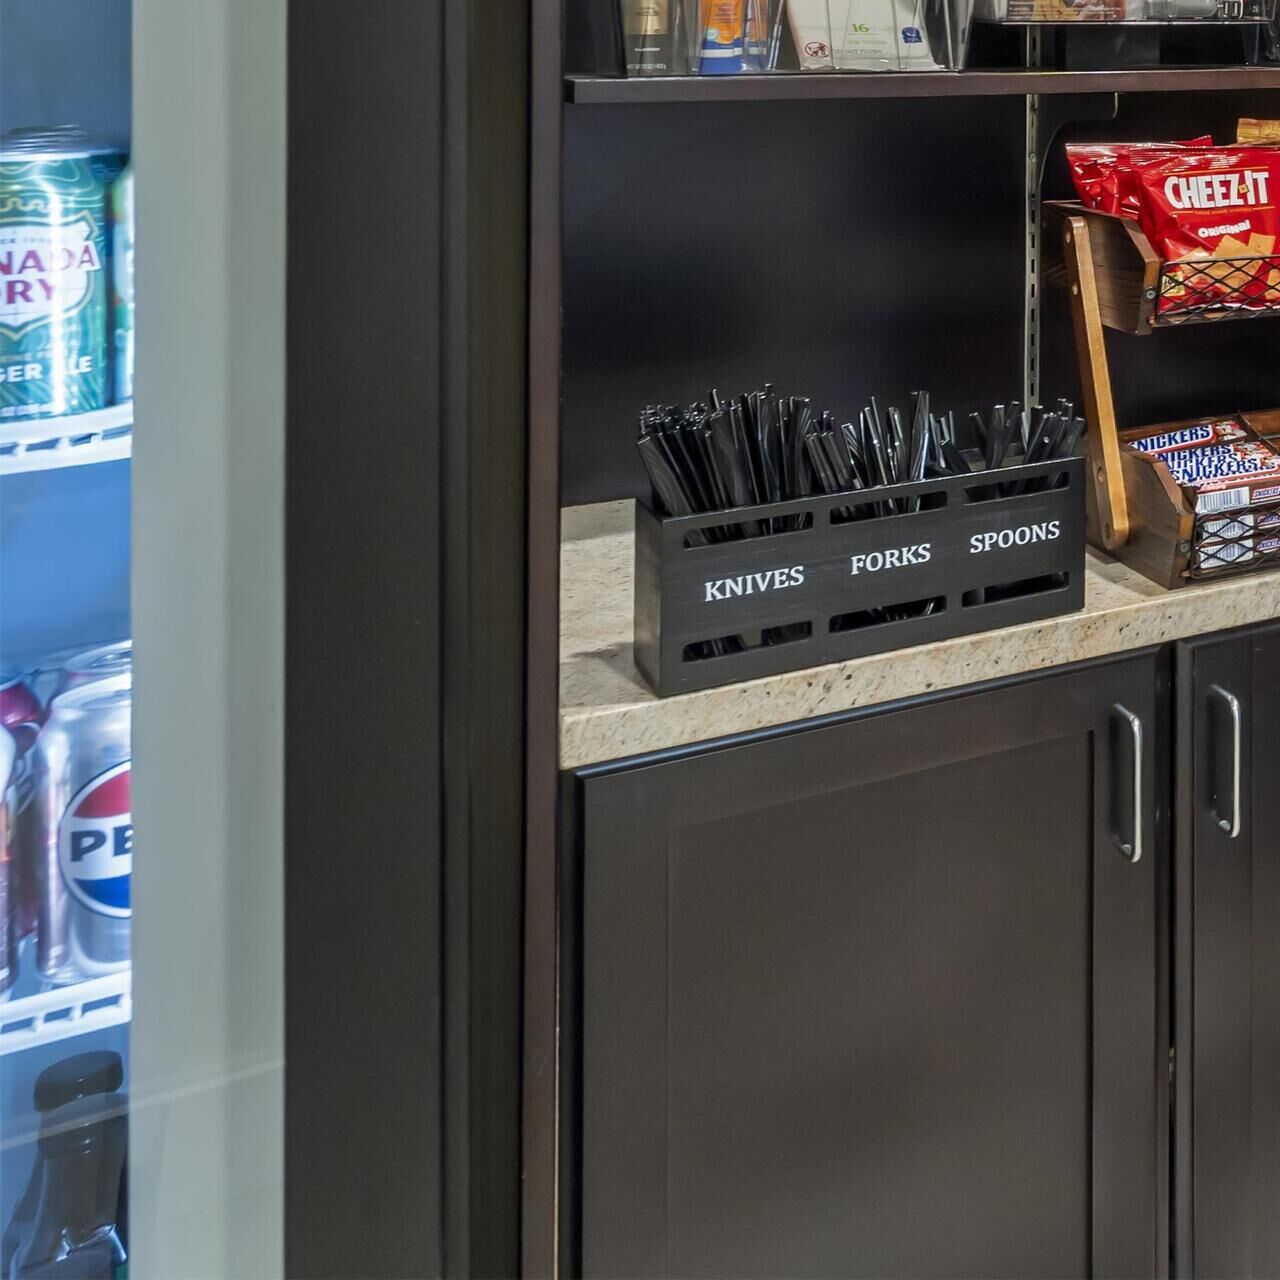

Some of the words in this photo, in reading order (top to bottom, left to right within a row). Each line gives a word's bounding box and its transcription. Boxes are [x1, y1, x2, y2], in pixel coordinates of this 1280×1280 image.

[852, 23, 869, 33] 16
[1164, 170, 1269, 208] CHEEZ-IT
[1129, 425, 1211, 452] NICKERS
[969, 521, 1060, 553] SPOONS
[850, 543, 932, 575] FORKS
[704, 565, 805, 602] KNIVES
